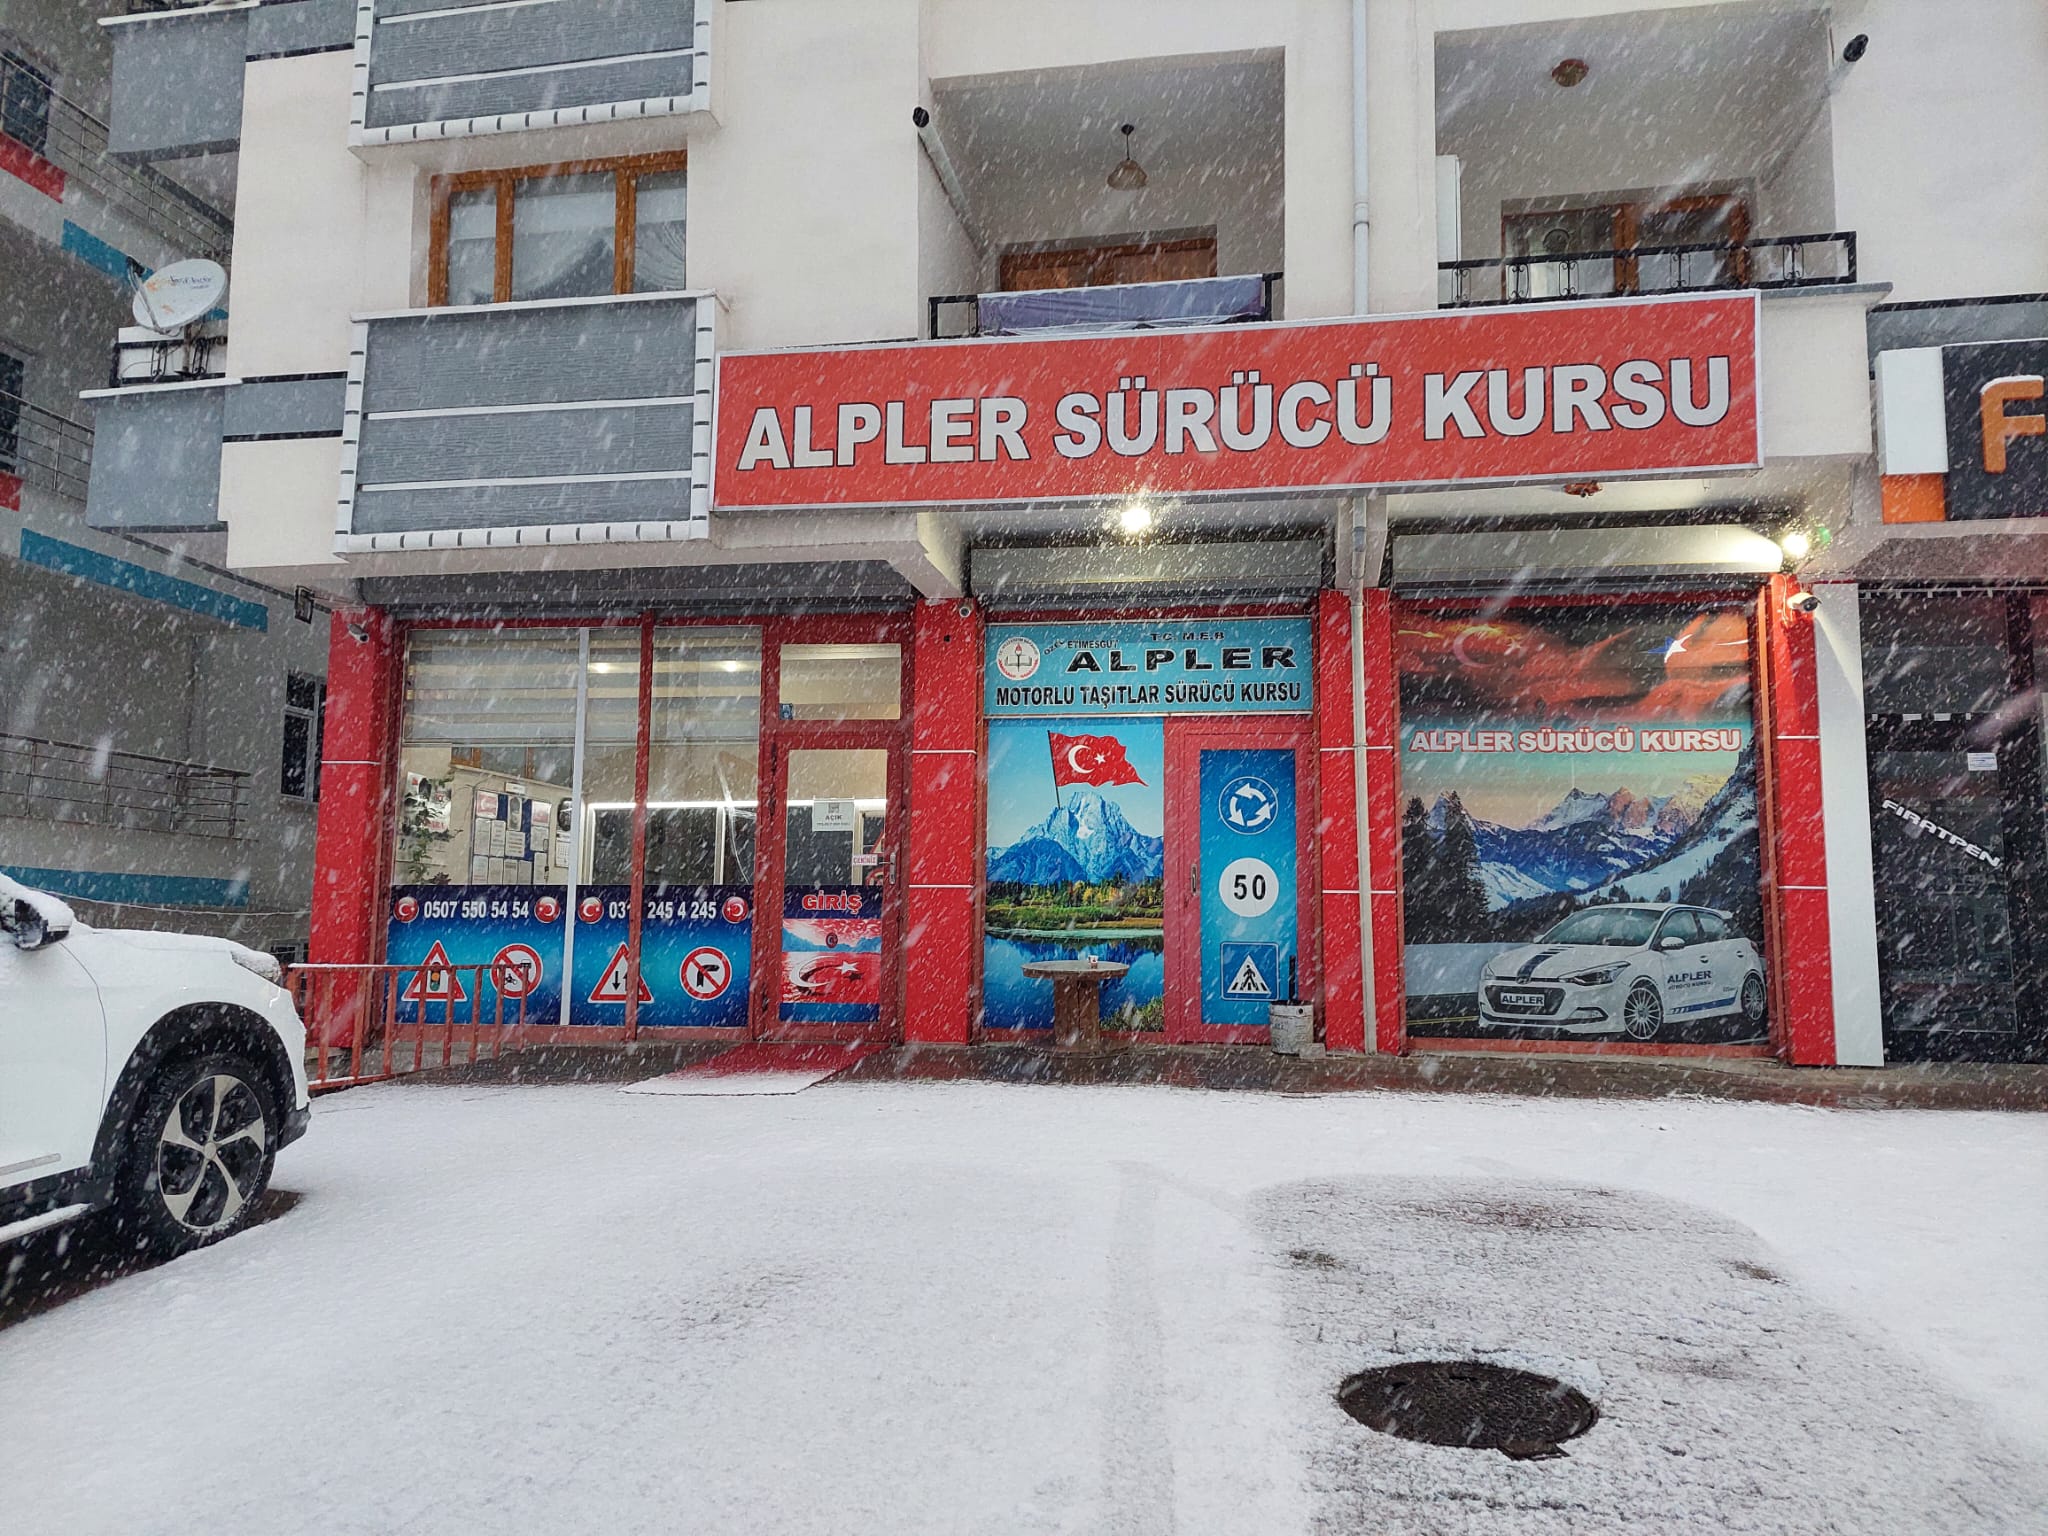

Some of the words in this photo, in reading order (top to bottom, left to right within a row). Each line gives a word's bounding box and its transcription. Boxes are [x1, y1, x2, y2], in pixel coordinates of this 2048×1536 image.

[736, 396, 1031, 471] ALPLER
[1052, 362, 1393, 459] SÜRÜCÜ
[1423, 355, 1731, 441] KURSU
[1065, 646, 1297, 672] ALPLER
[996, 685, 1075, 706] MOTORLU
[1080, 684, 1159, 709] TAŞITLAR
[1165, 679, 1235, 704] SÜRÜCÜ
[1241, 682, 1301, 702] KURSU
[1409, 730, 1514, 752] ALPLER
[1517, 727, 1635, 752] SÜRÜCÜ
[1640, 728, 1743, 752] KURSU
[1882, 799, 2001, 867] FIRATPEN
[1233, 874, 1266, 900] 50
[424, 901, 458, 918] 0507
[461, 901, 487, 918] 550
[491, 901, 508, 918] 54
[511, 901, 529, 918] 54
[647, 901, 673, 918] 245
[677, 901, 687, 918] 4
[690, 901, 717, 918] 245
[802, 889, 863, 915] GİRİŞ
[1667, 970, 1712, 984] ALPLER
[1502, 995, 1544, 1005] ALPLER
